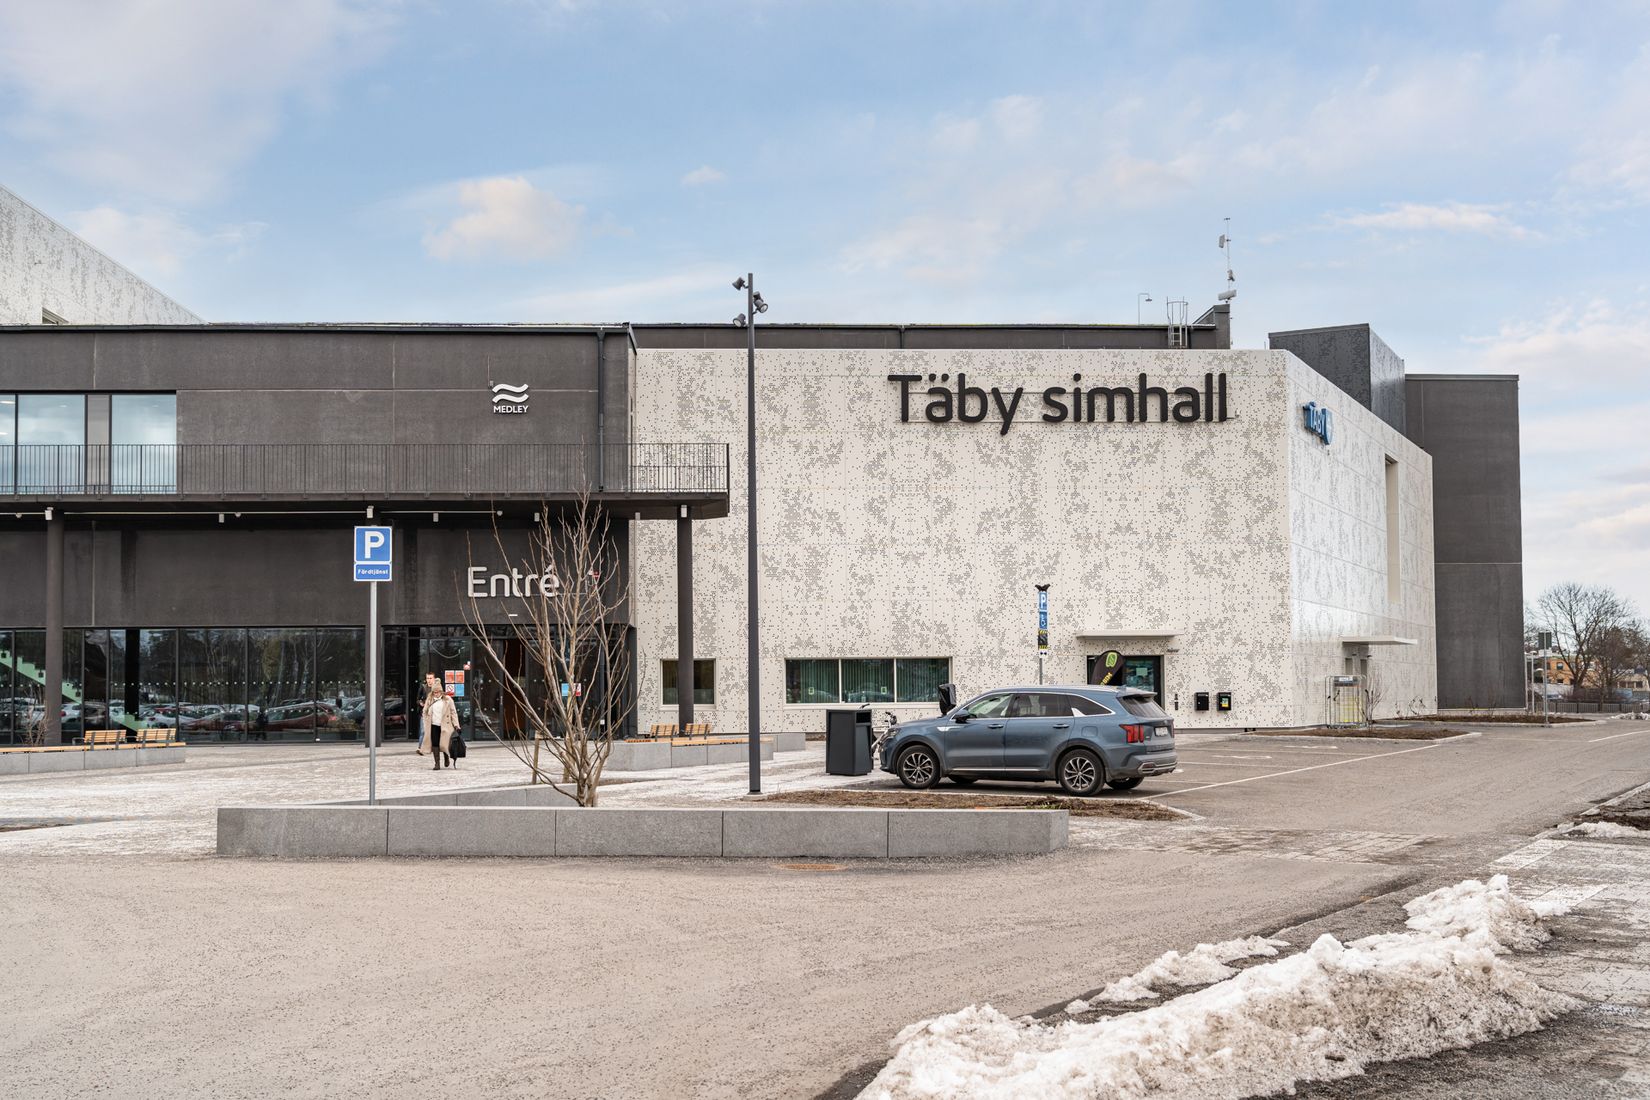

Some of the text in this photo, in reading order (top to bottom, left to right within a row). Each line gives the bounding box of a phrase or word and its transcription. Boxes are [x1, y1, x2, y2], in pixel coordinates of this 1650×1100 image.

[493, 405, 529, 413] MEDLEY
[887, 373, 1227, 436] Täby simhall
[364, 531, 385, 559] P
[467, 564, 560, 598] Entré
[1040, 594, 1047, 609] P
